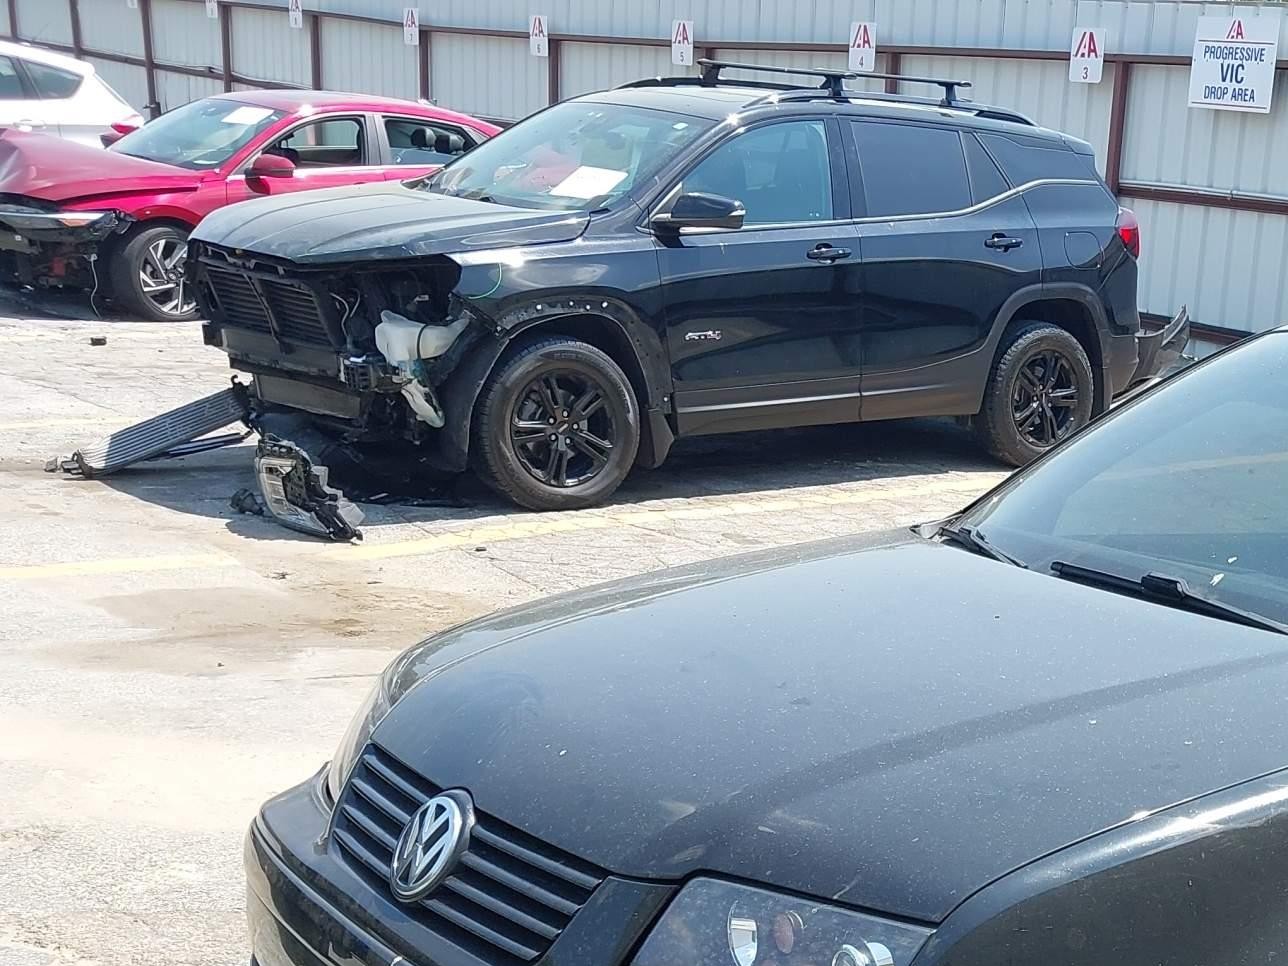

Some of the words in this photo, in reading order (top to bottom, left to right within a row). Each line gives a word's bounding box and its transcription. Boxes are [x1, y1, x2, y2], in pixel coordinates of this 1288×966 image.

[1203, 45, 1266, 62] PROGRESSIVE
[1081, 67, 1088, 80] 3
[1220, 62, 1246, 84] VIC
[1203, 85, 1228, 101] DROP
[1229, 87, 1255, 103] AREA
